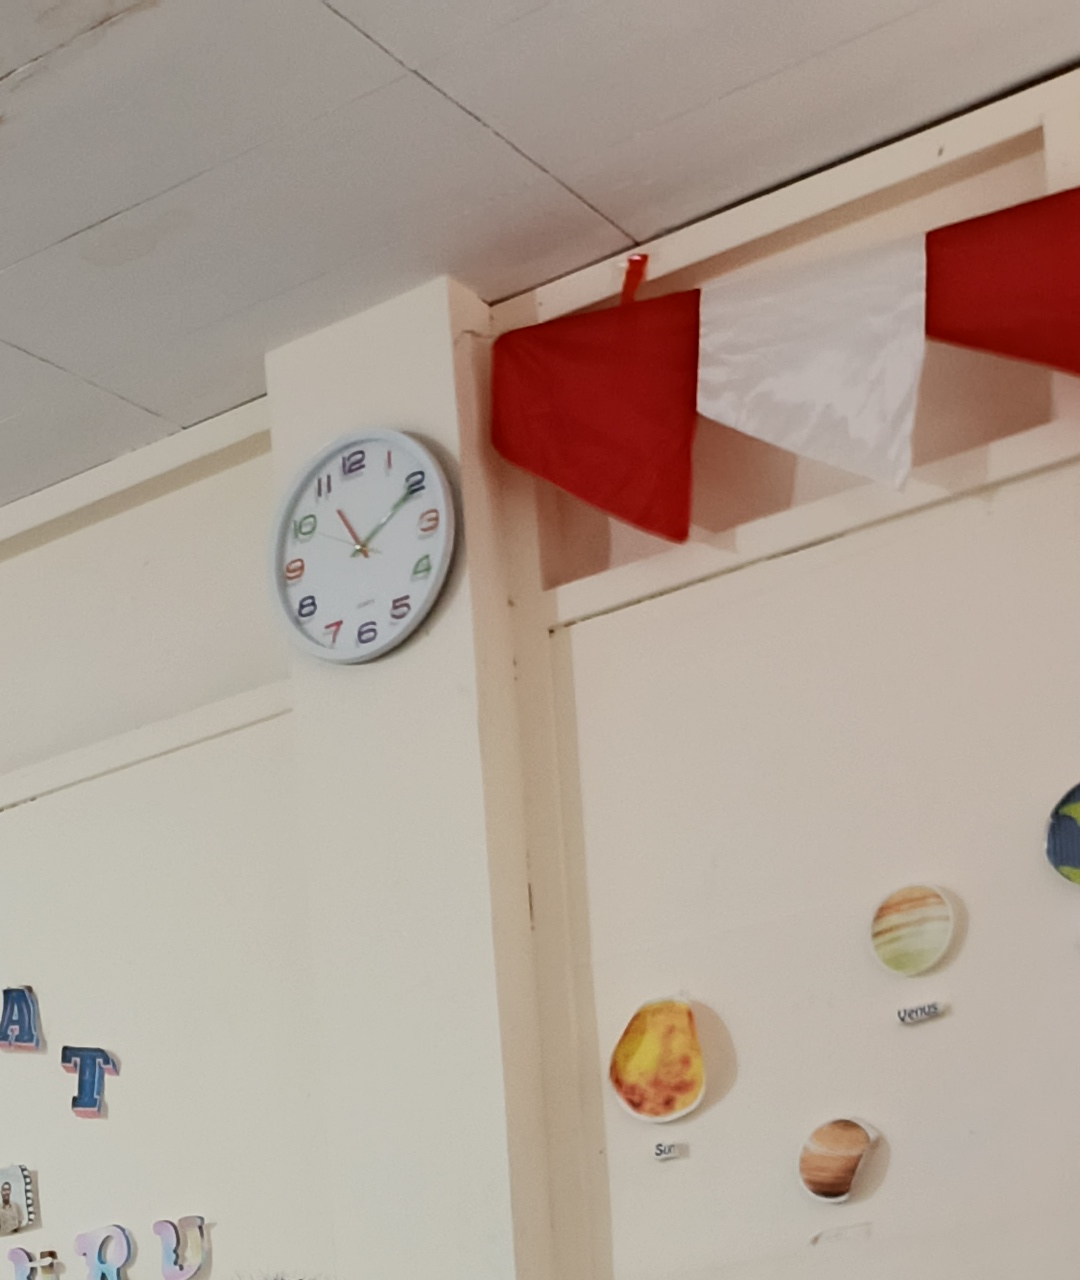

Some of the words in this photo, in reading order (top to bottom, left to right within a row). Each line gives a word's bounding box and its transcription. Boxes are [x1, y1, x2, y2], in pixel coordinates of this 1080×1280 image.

[342, 450, 366, 475] 12
[386, 450, 392, 469] 1
[317, 474, 332, 497] 11
[405, 470, 426, 495] 2
[293, 513, 318, 539] 10
[419, 508, 440, 532] 3
[285, 558, 305, 580] 9
[412, 554, 432, 576] 4
[297, 595, 318, 618] 8
[390, 595, 412, 620] 5
[324, 620, 344, 644] 7
[357, 621, 378, 644] 6
[897, 1002, 938, 1022] Venus
